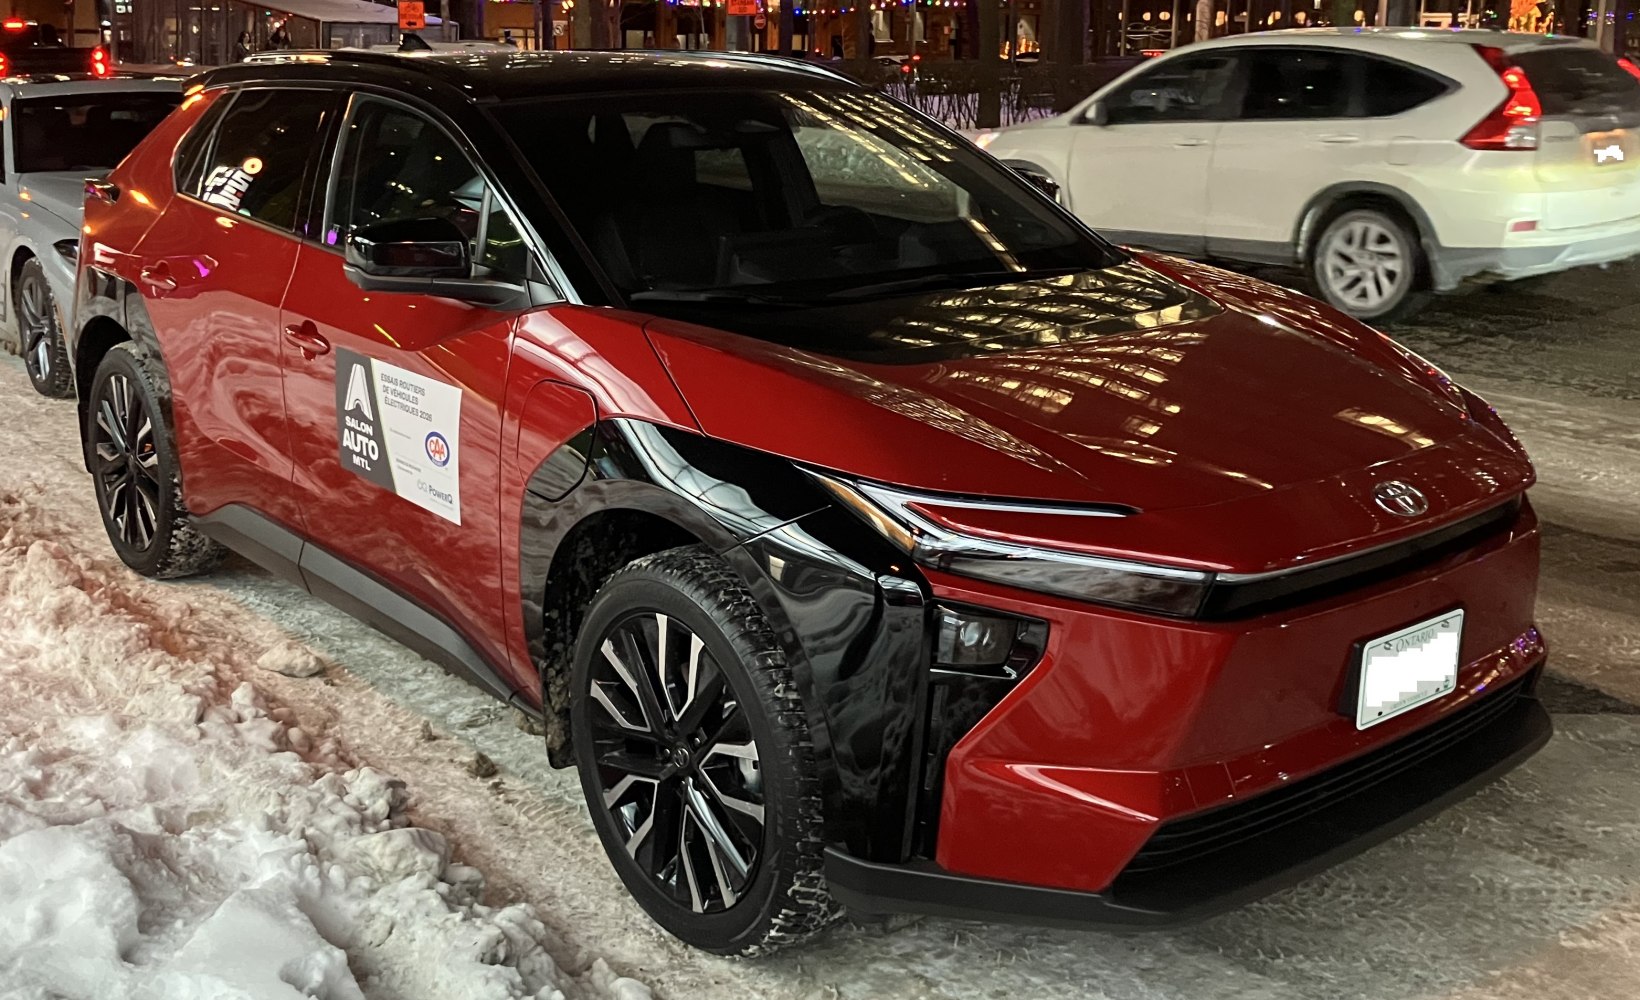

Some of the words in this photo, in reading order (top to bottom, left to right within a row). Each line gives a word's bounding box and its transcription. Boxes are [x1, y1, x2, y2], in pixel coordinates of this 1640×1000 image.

[381, 373, 398, 386] ESSAIS
[399, 381, 425, 397] ROUTIERS
[382, 385, 390, 395] DE
[390, 387, 418, 405] VÉHICULES
[384, 396, 419, 417] ÉLECTRIQUES
[419, 411, 433, 422] 2026
[345, 415, 373, 436] SALON
[343, 428, 379, 461] AUTO
[429, 439, 446, 461] CAA
[353, 454, 371, 471] MTL
[1396, 629, 1434, 652] ONTARIO
